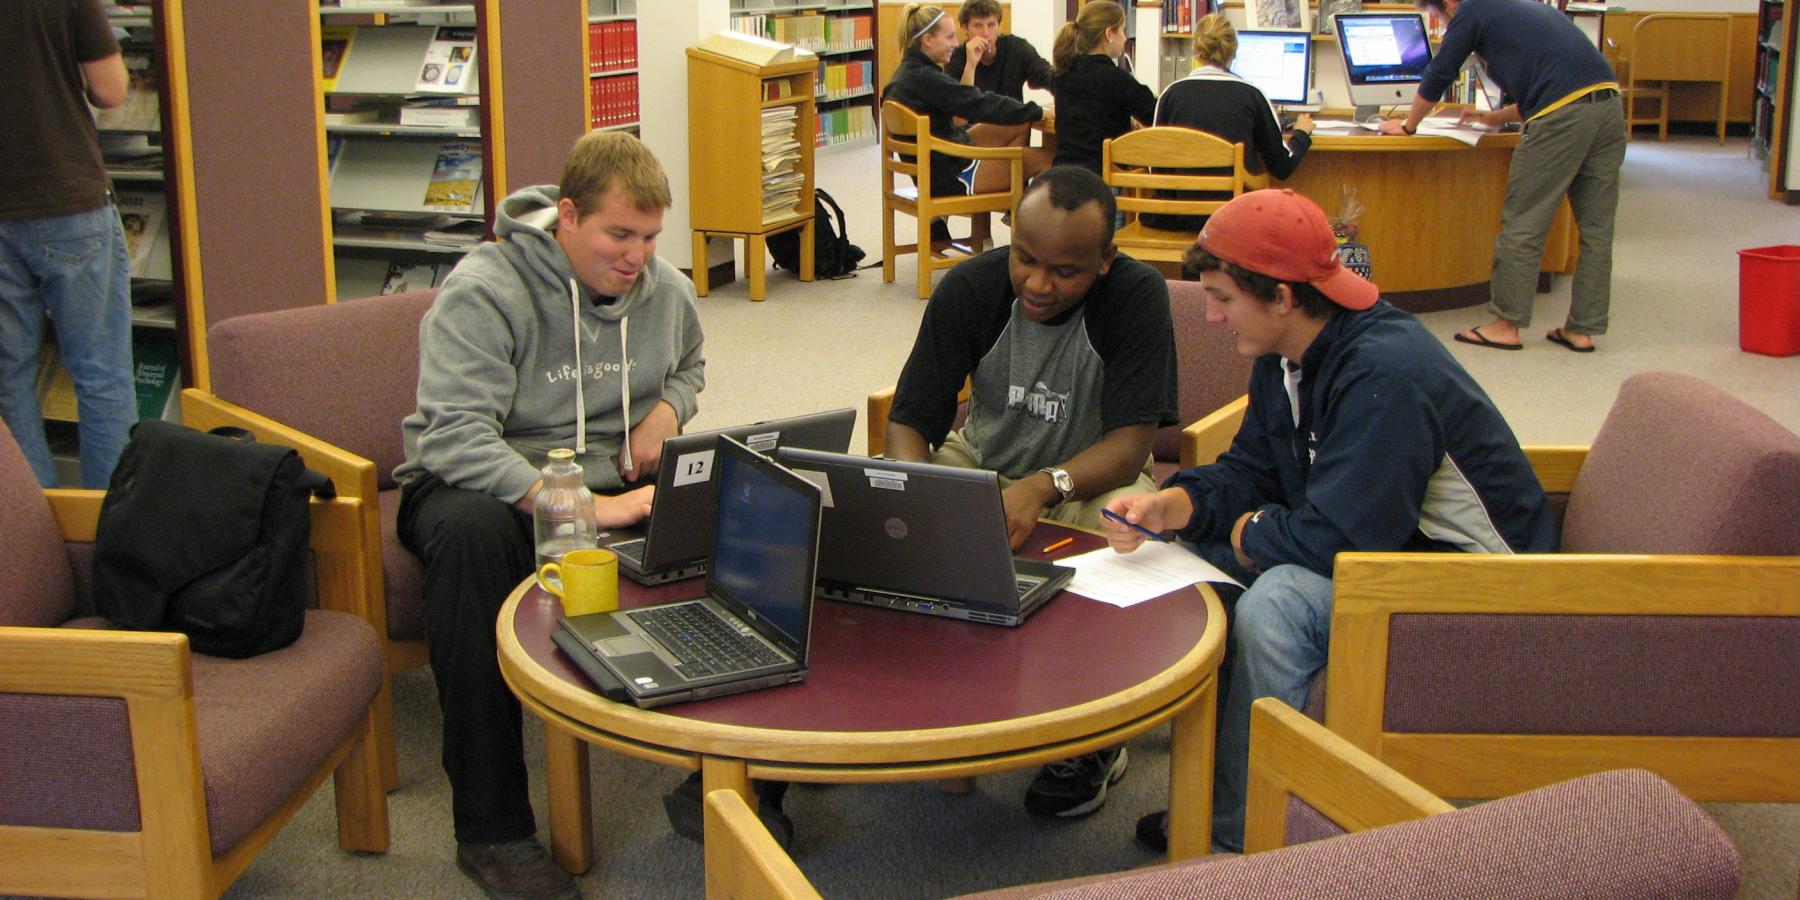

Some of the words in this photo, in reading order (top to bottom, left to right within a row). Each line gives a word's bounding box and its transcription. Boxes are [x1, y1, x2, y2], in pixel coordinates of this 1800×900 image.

[546, 364, 577, 383] Life
[584, 365, 594, 375] is
[1008, 385, 1059, 422] PMA
[687, 461, 704, 476] 12
